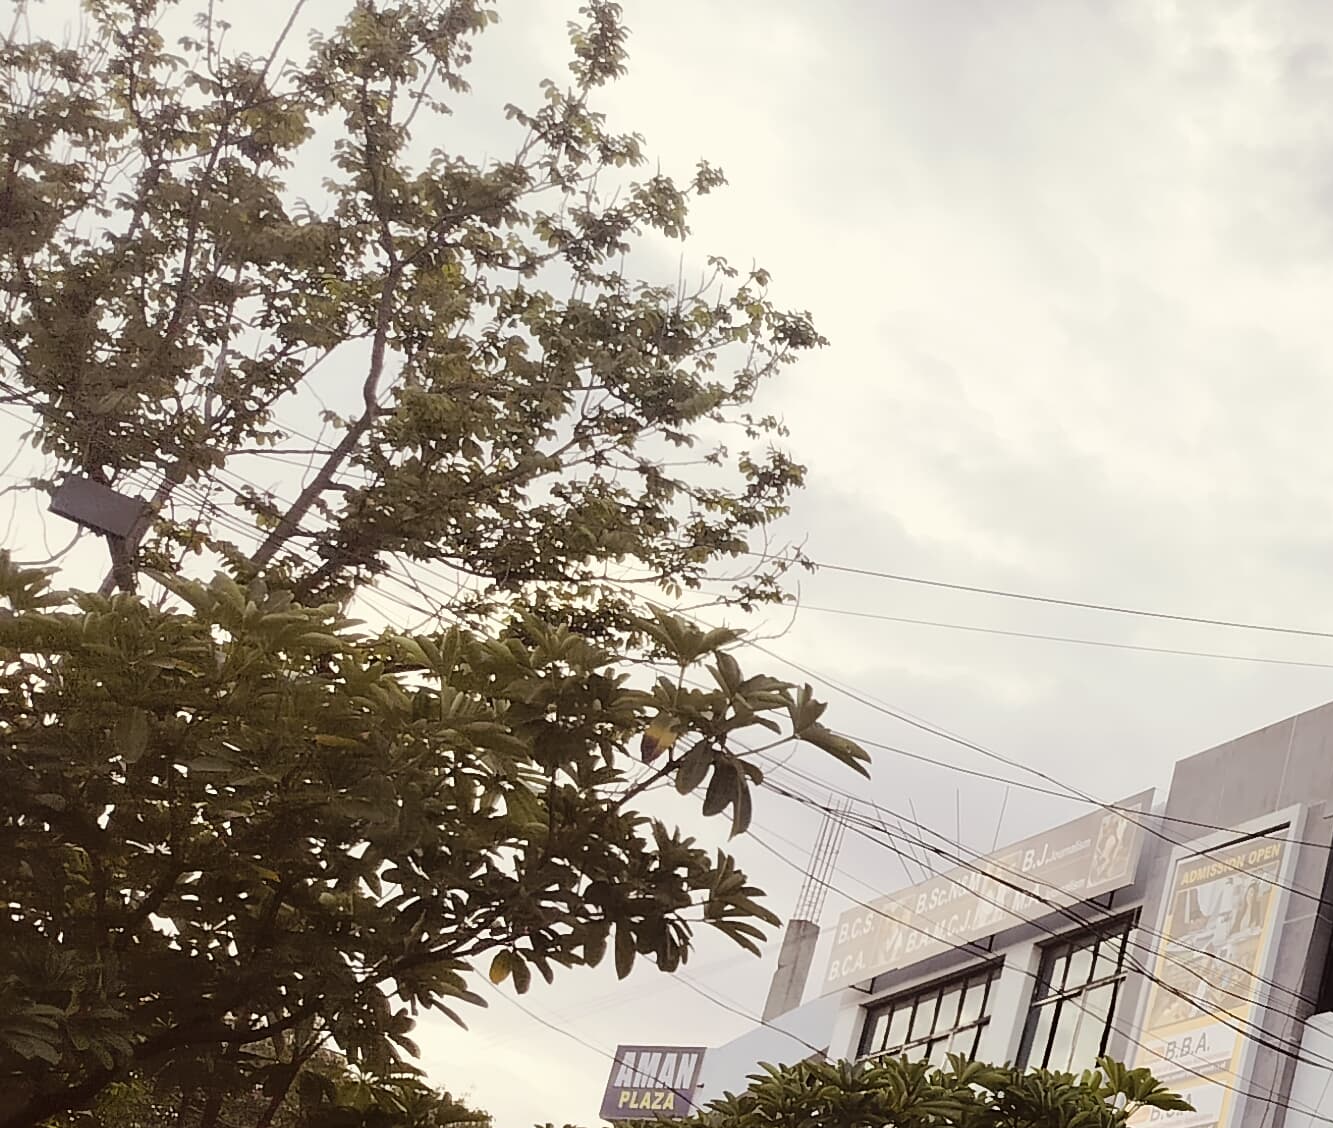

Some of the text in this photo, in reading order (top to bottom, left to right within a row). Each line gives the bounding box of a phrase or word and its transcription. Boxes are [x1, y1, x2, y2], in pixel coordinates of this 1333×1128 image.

[1180, 842, 1282, 886] ADMISSION OPEN
[1165, 1032, 1210, 1060] B.B.A.
[614, 1051, 698, 1090] AMAN
[618, 1091, 675, 1110] PLAZA
